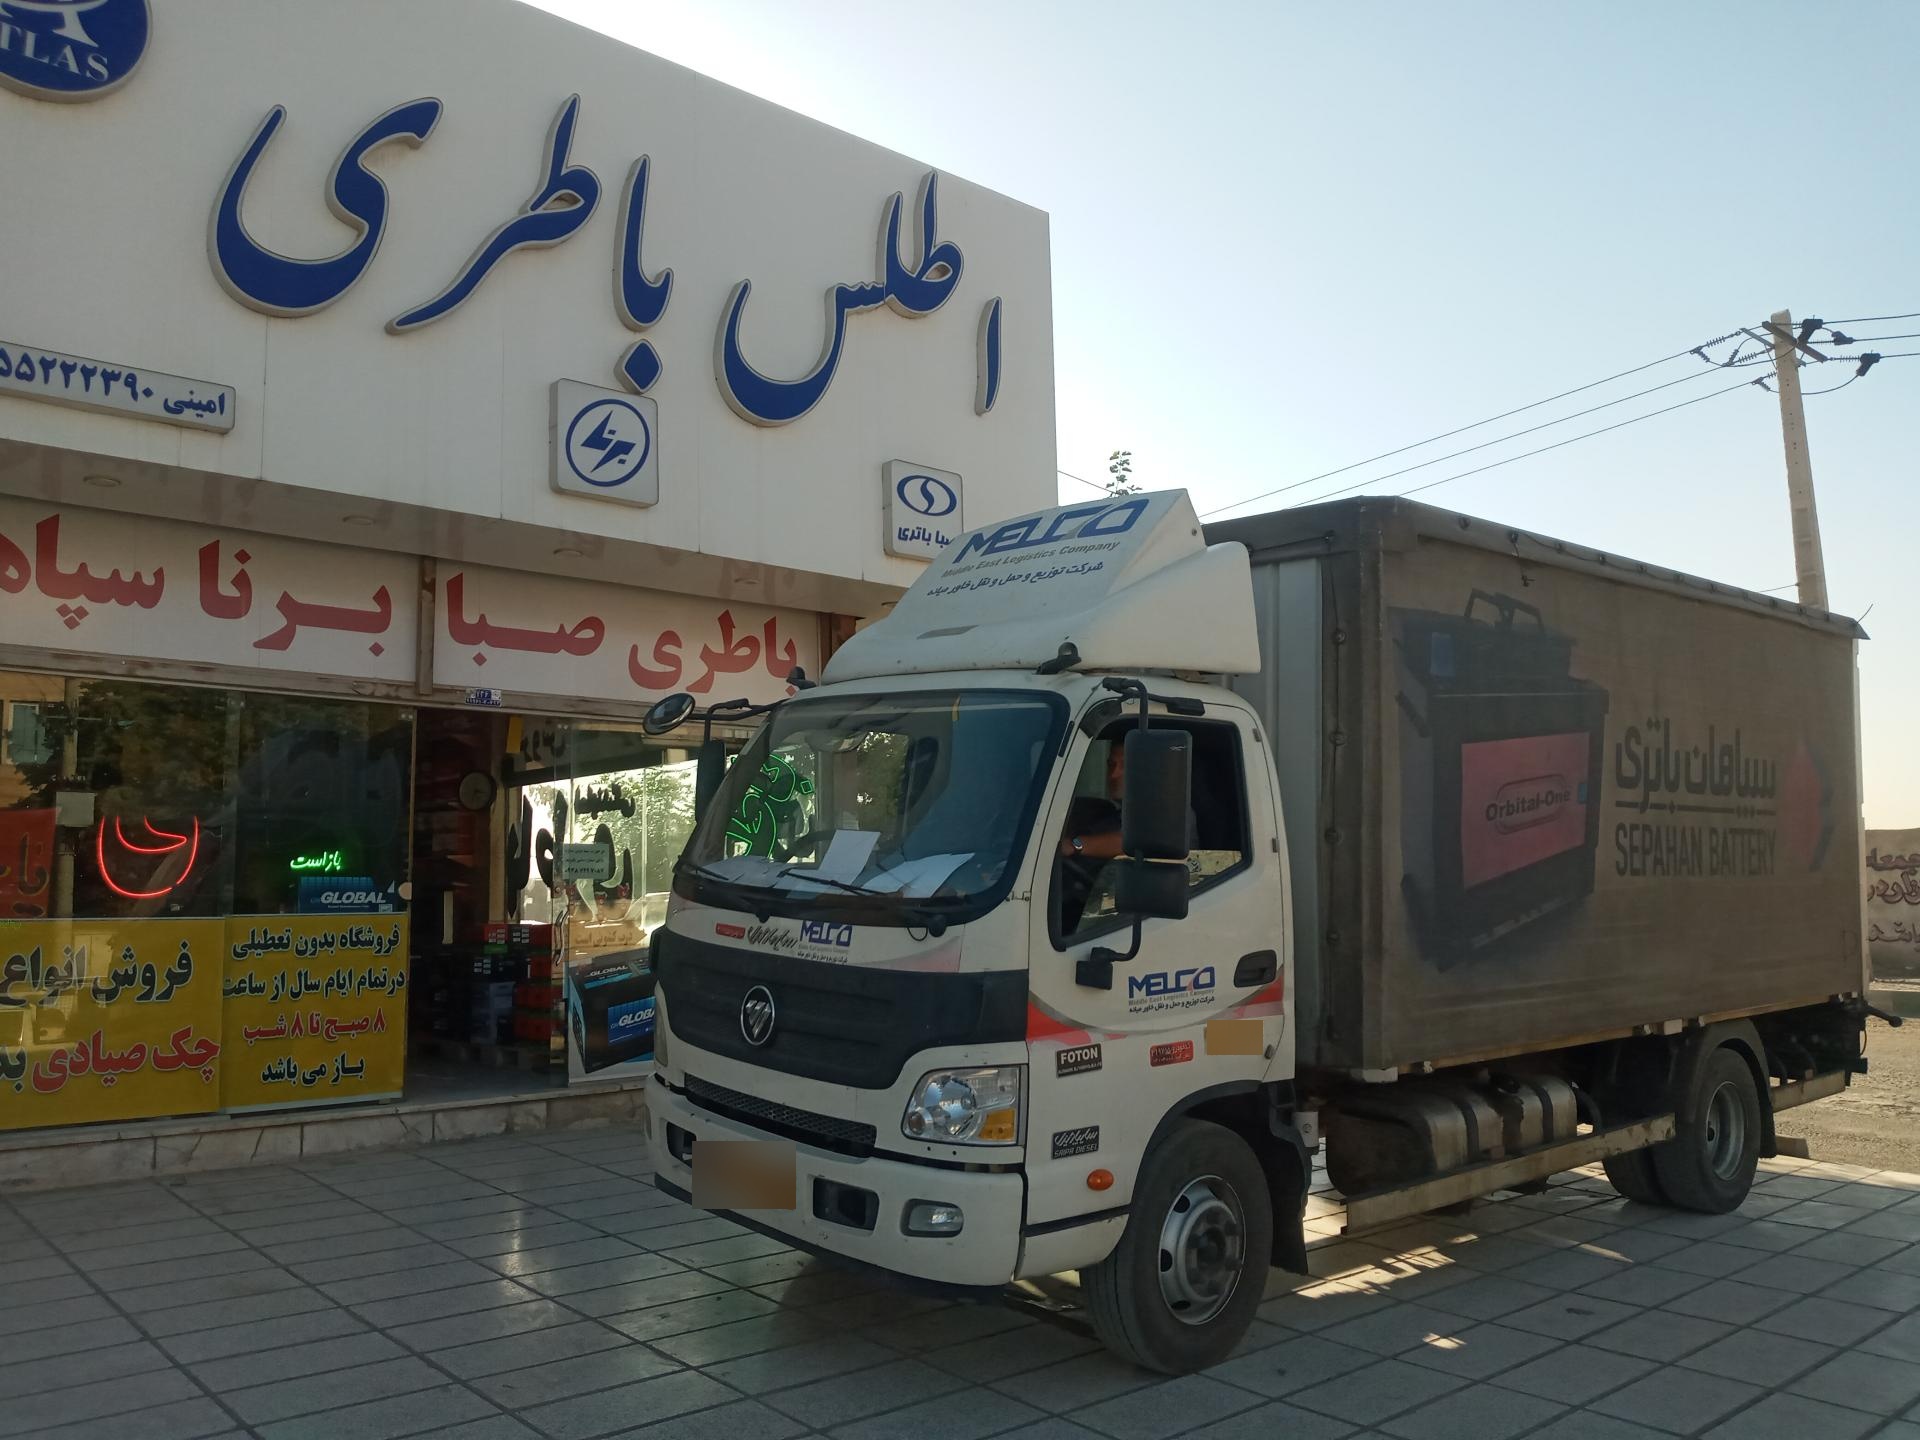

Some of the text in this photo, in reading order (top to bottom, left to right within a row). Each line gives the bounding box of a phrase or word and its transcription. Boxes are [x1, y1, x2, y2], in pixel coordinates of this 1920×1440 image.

[0, 22, 110, 81] TLAS
[207, 93, 1002, 428] اطلس باطری
[163, 390, 227, 418] امینی
[897, 526, 932, 546] باتری
[953, 498, 1150, 564] MELCO
[976, 557, 1001, 570] East
[1002, 548, 1055, 565] Logistics
[1058, 541, 1121, 555] Company
[1066, 561, 1104, 574] شرکت
[0, 513, 392, 657] برنا سپاه
[969, 577, 990, 591] نقل
[1000, 572, 1024, 586] حمل
[1030, 566, 1065, 584] توزیع
[446, 572, 798, 697] باطری صبا
[1685, 724, 1777, 820] سپاهان
[1485, 789, 1571, 822] Orbital-One
[1614, 822, 1777, 877] SEPAHAN BATTERY
[320, 891, 387, 904] GLOBAL
[231, 924, 401, 959] فروشگاه بدون تعطیلی
[801, 920, 853, 947] MELCO
[0, 938, 194, 1007] فروش انواع
[223, 971, 267, 997] ساعت
[269, 970, 287, 1003] از
[289, 969, 322, 1000] سال
[325, 968, 354, 998] ایام
[590, 965, 629, 977] GLOBAL
[1128, 966, 1216, 999] MELCO
[243, 1007, 387, 1047] ۸ صبح تا ۸ شب
[32, 1027, 148, 1093] صیادی
[151, 1026, 222, 1084] چک
[261, 1052, 365, 1086] باز می باشد
[1060, 1046, 1099, 1065] FOTON
[1075, 1143, 1098, 1155] DIESEL
